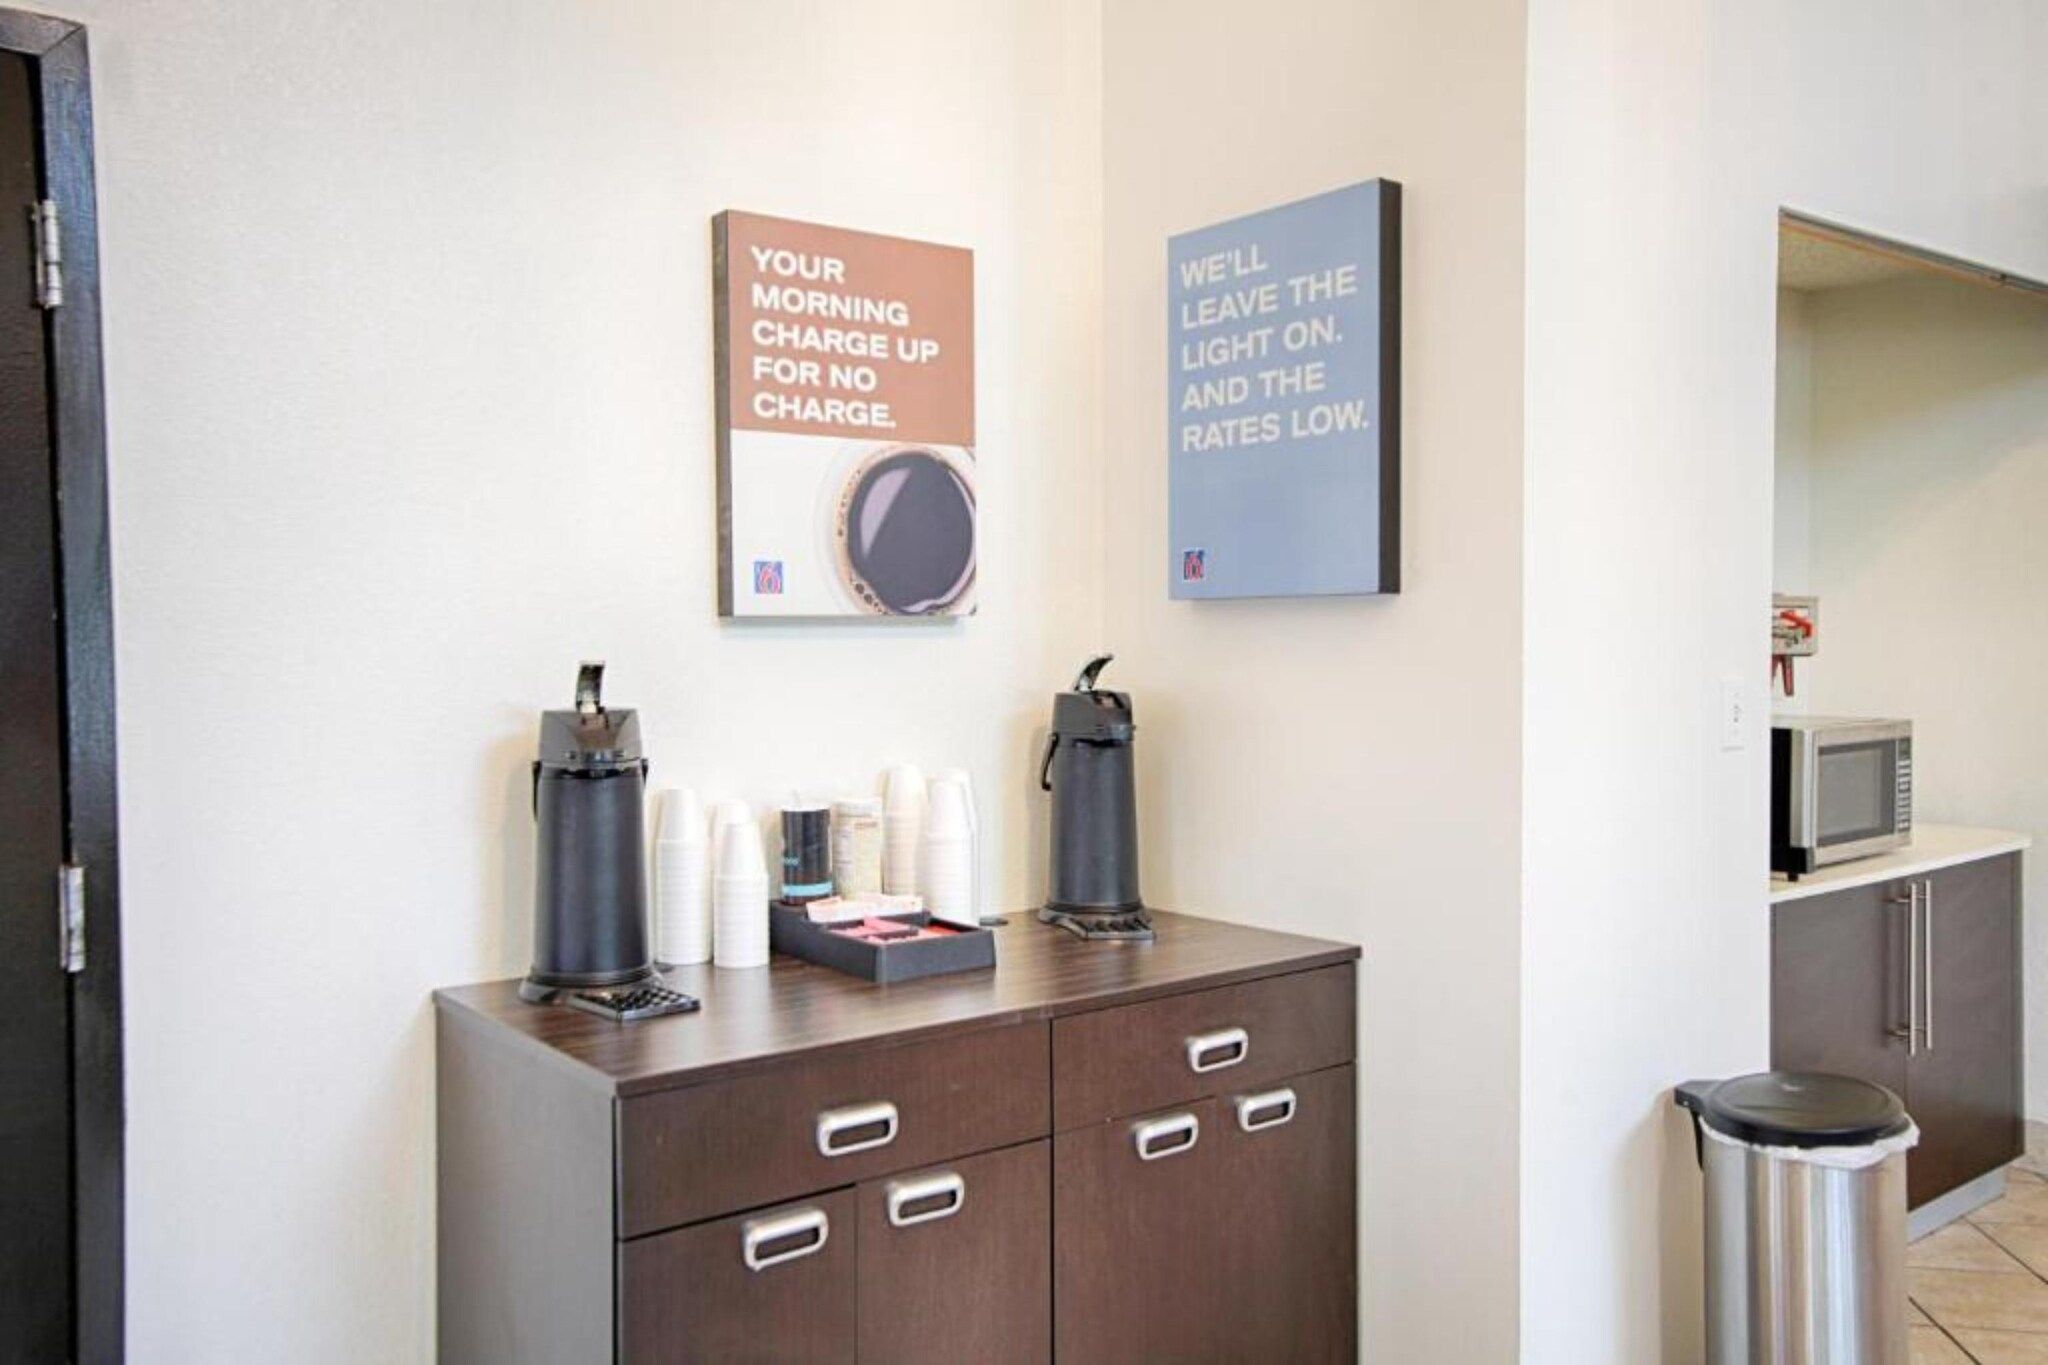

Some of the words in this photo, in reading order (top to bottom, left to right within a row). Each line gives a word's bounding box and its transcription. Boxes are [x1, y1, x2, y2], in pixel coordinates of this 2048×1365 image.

[752, 246, 843, 281] YOUR
[1181, 245, 1266, 287] WE'LL
[752, 284, 908, 325] MORNING
[1182, 284, 1276, 328] LEAVE
[1289, 265, 1356, 306] THE
[752, 321, 887, 357] CHARGE
[898, 339, 938, 361] UP
[1182, 328, 1271, 369] LIGHT
[1284, 315, 1341, 350] ON.
[754, 357, 819, 385] FOR
[830, 365, 875, 389] NO
[1182, 376, 1246, 410] AND
[1259, 363, 1324, 397] THE
[754, 393, 895, 426] CHARGE.
[1183, 413, 1279, 450] RATES
[1292, 401, 1367, 437] LOW.
